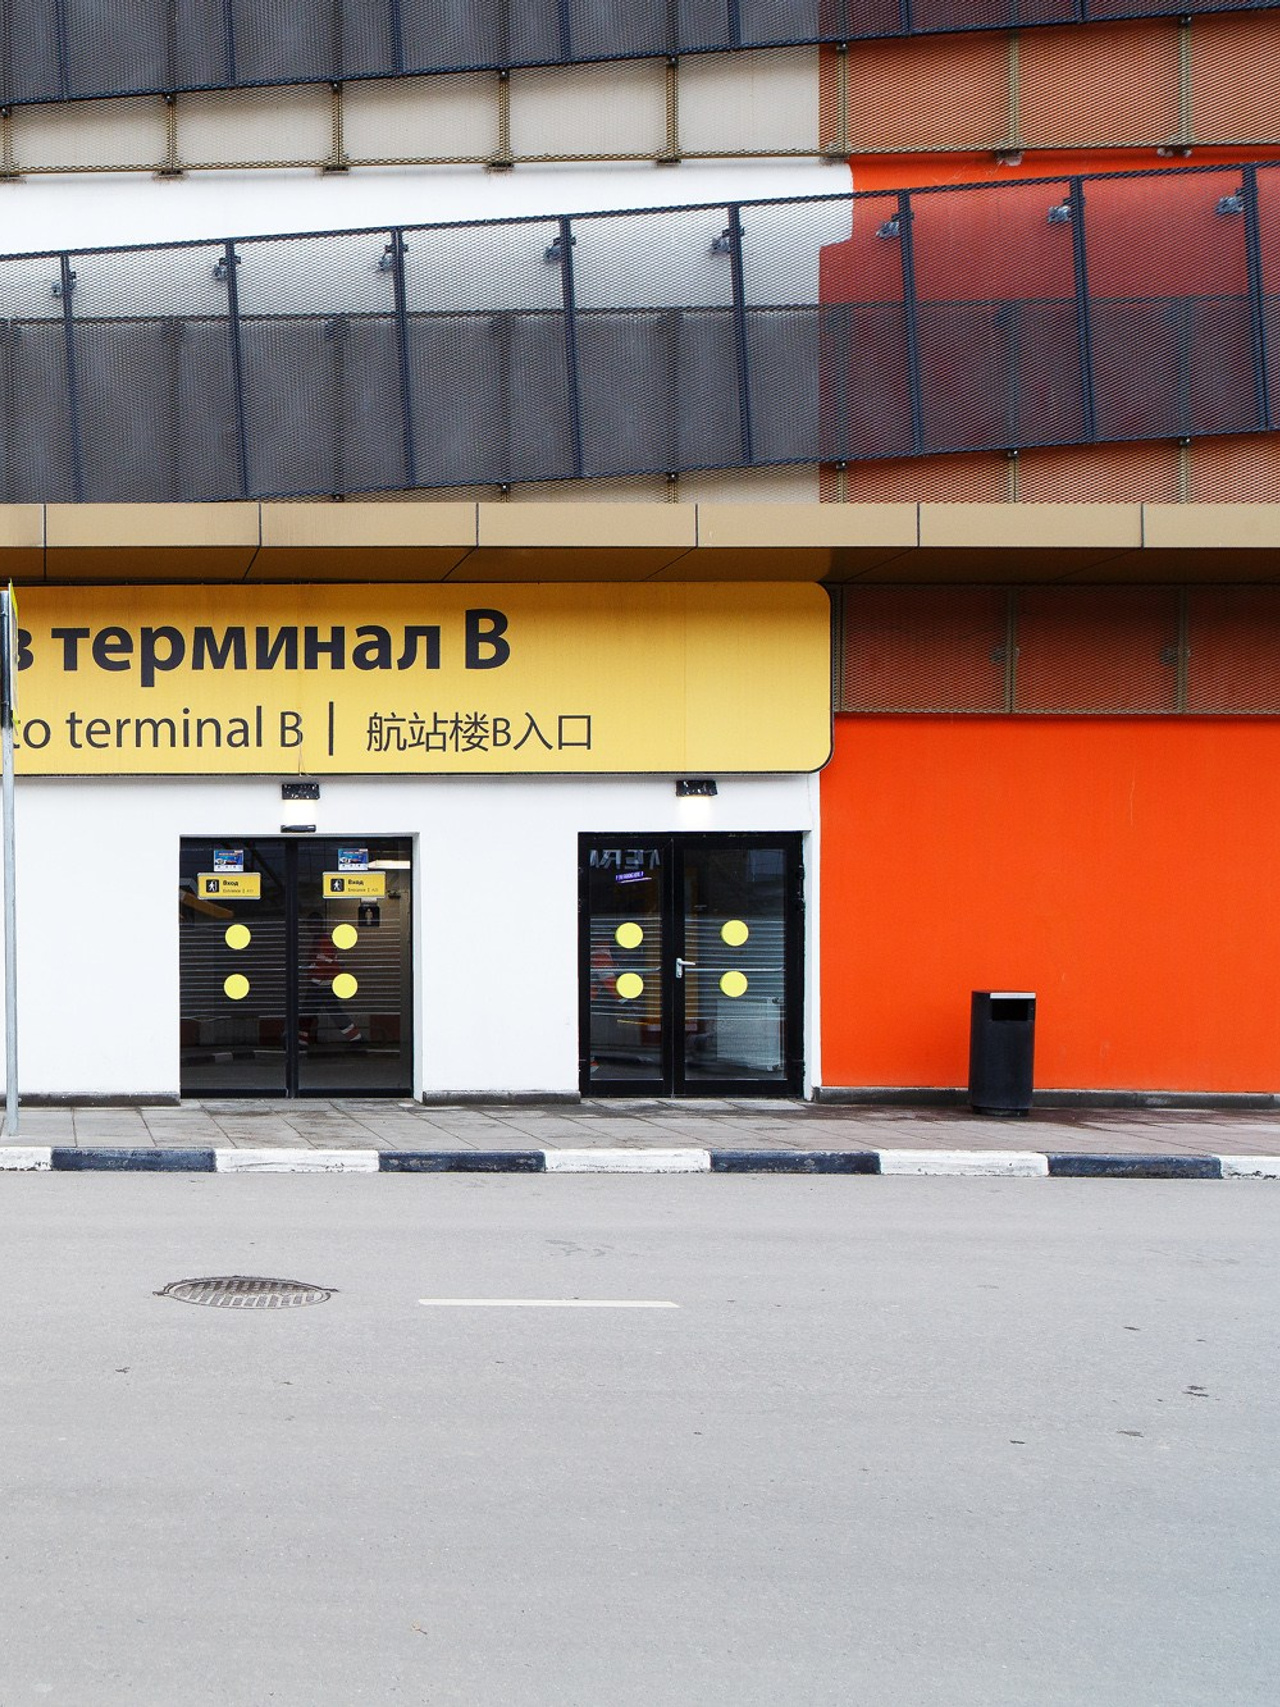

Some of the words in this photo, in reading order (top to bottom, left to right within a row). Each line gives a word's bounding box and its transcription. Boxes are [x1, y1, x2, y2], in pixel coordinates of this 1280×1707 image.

[51, 624, 441, 688] терминал
[65, 705, 263, 749] terminal
[280, 710, 304, 748] B
[366, 711, 593, 753] 航站楼B入口
